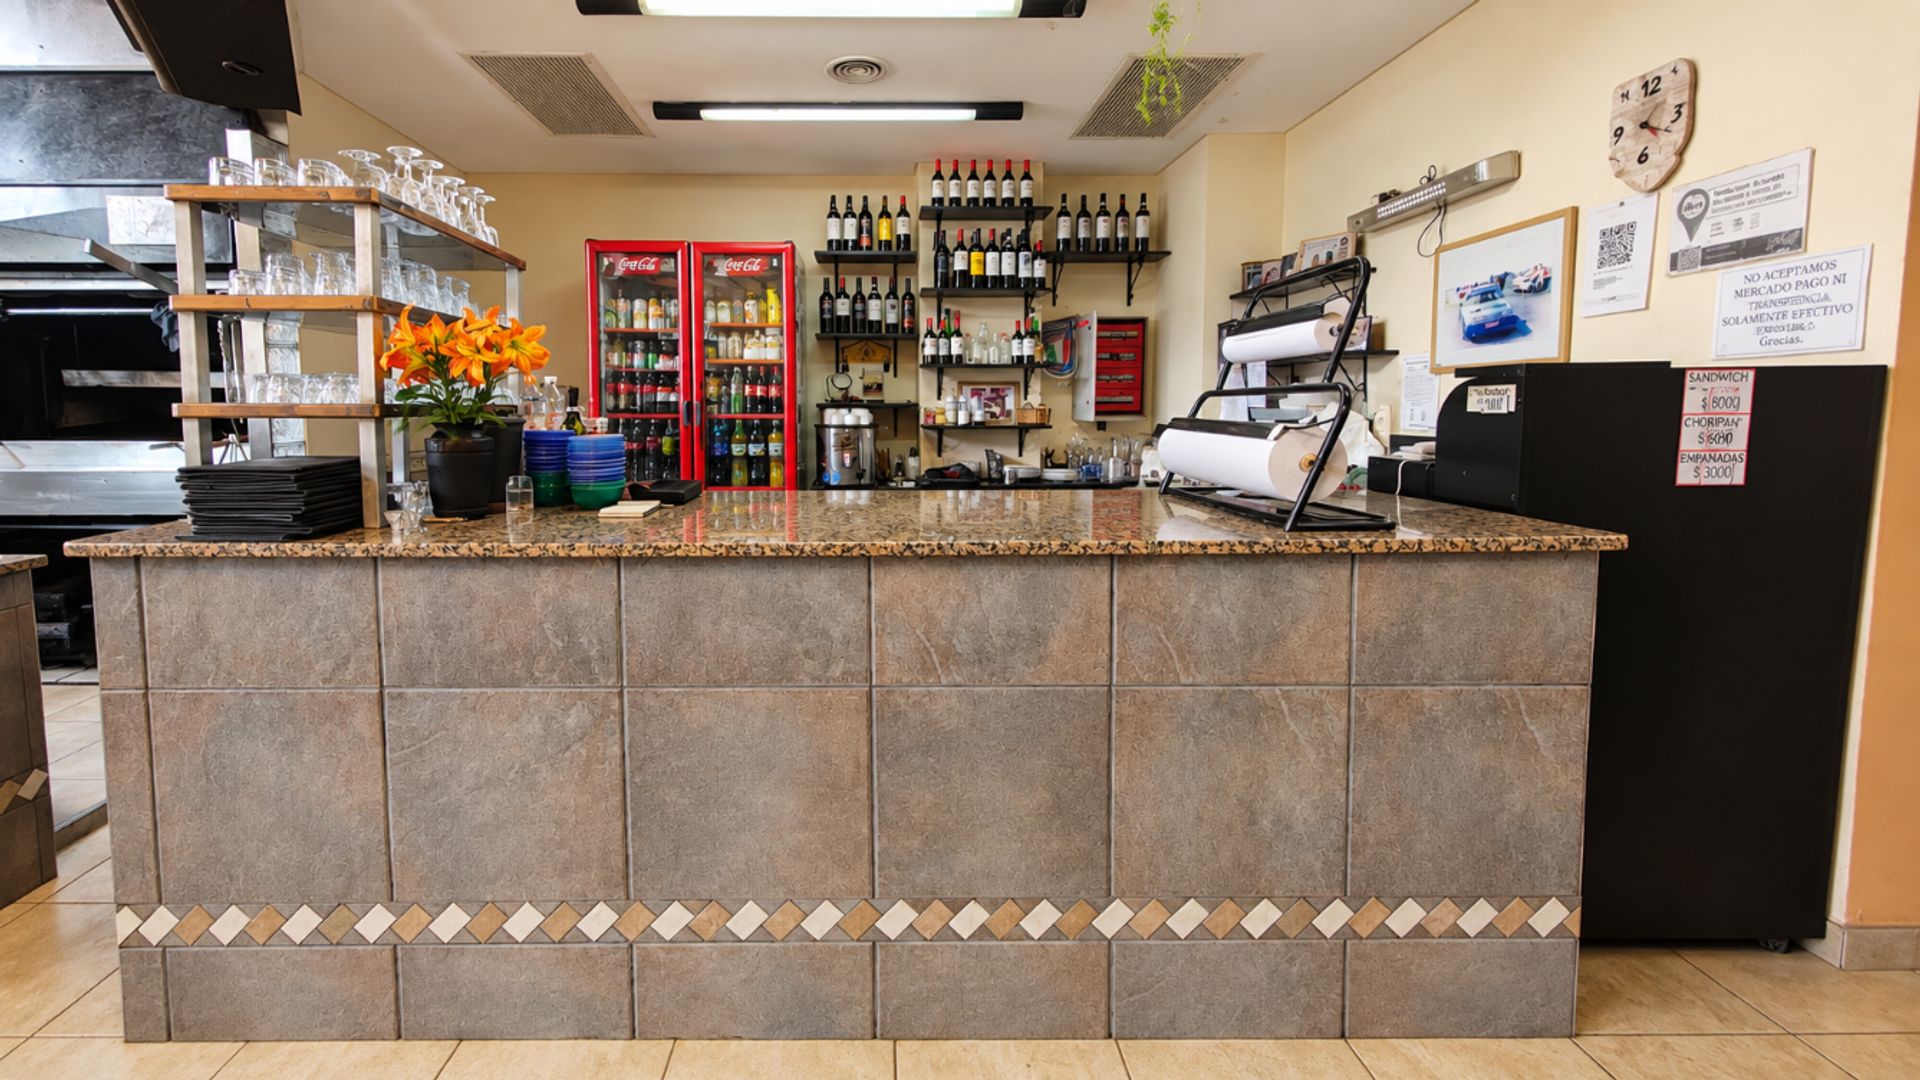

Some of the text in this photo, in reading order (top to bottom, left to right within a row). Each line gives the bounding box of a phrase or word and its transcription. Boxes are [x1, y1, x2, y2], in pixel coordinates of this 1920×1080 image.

[1641, 75, 1662, 98] 12
[1670, 101, 1687, 124] 3
[1613, 126, 1624, 146] 9
[1637, 146, 1649, 164] 6
[1743, 260, 1838, 285] NO ACEPTAMOS
[1734, 273, 1847, 299] MERCADO PAGO NI
[1722, 303, 1854, 327] SOLAMENTE EFECTIVO
[1689, 372, 1749, 382] SANDWICH
[1680, 453, 1744, 464] EMPANADAS
